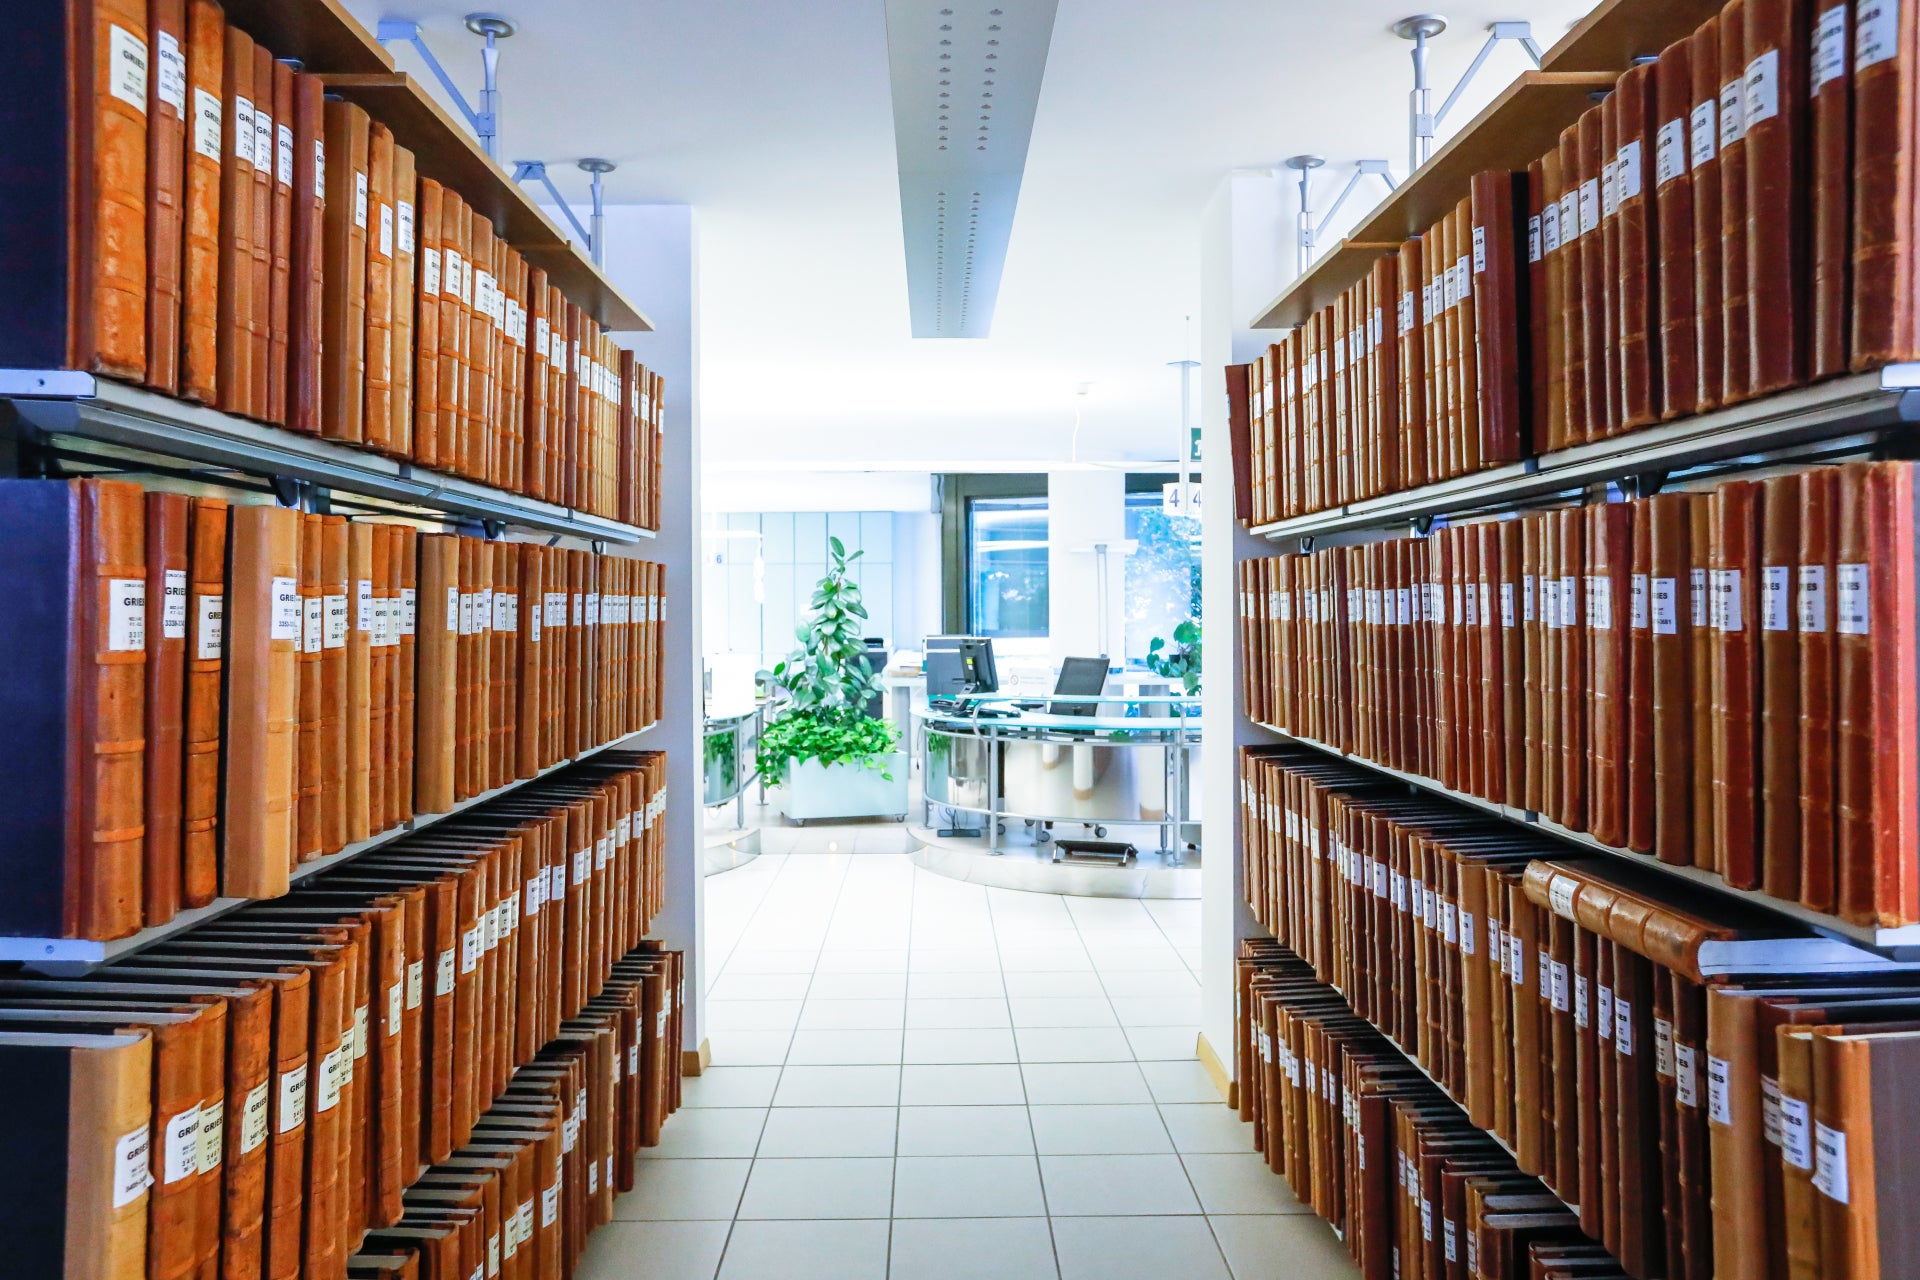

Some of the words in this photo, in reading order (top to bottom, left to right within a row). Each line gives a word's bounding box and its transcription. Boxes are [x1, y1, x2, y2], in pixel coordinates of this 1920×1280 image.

[1168, 488, 1180, 508] 4
[1192, 490, 1202, 508] 4
[716, 554, 722, 564] 6
[204, 1115, 223, 1134] GRIES
